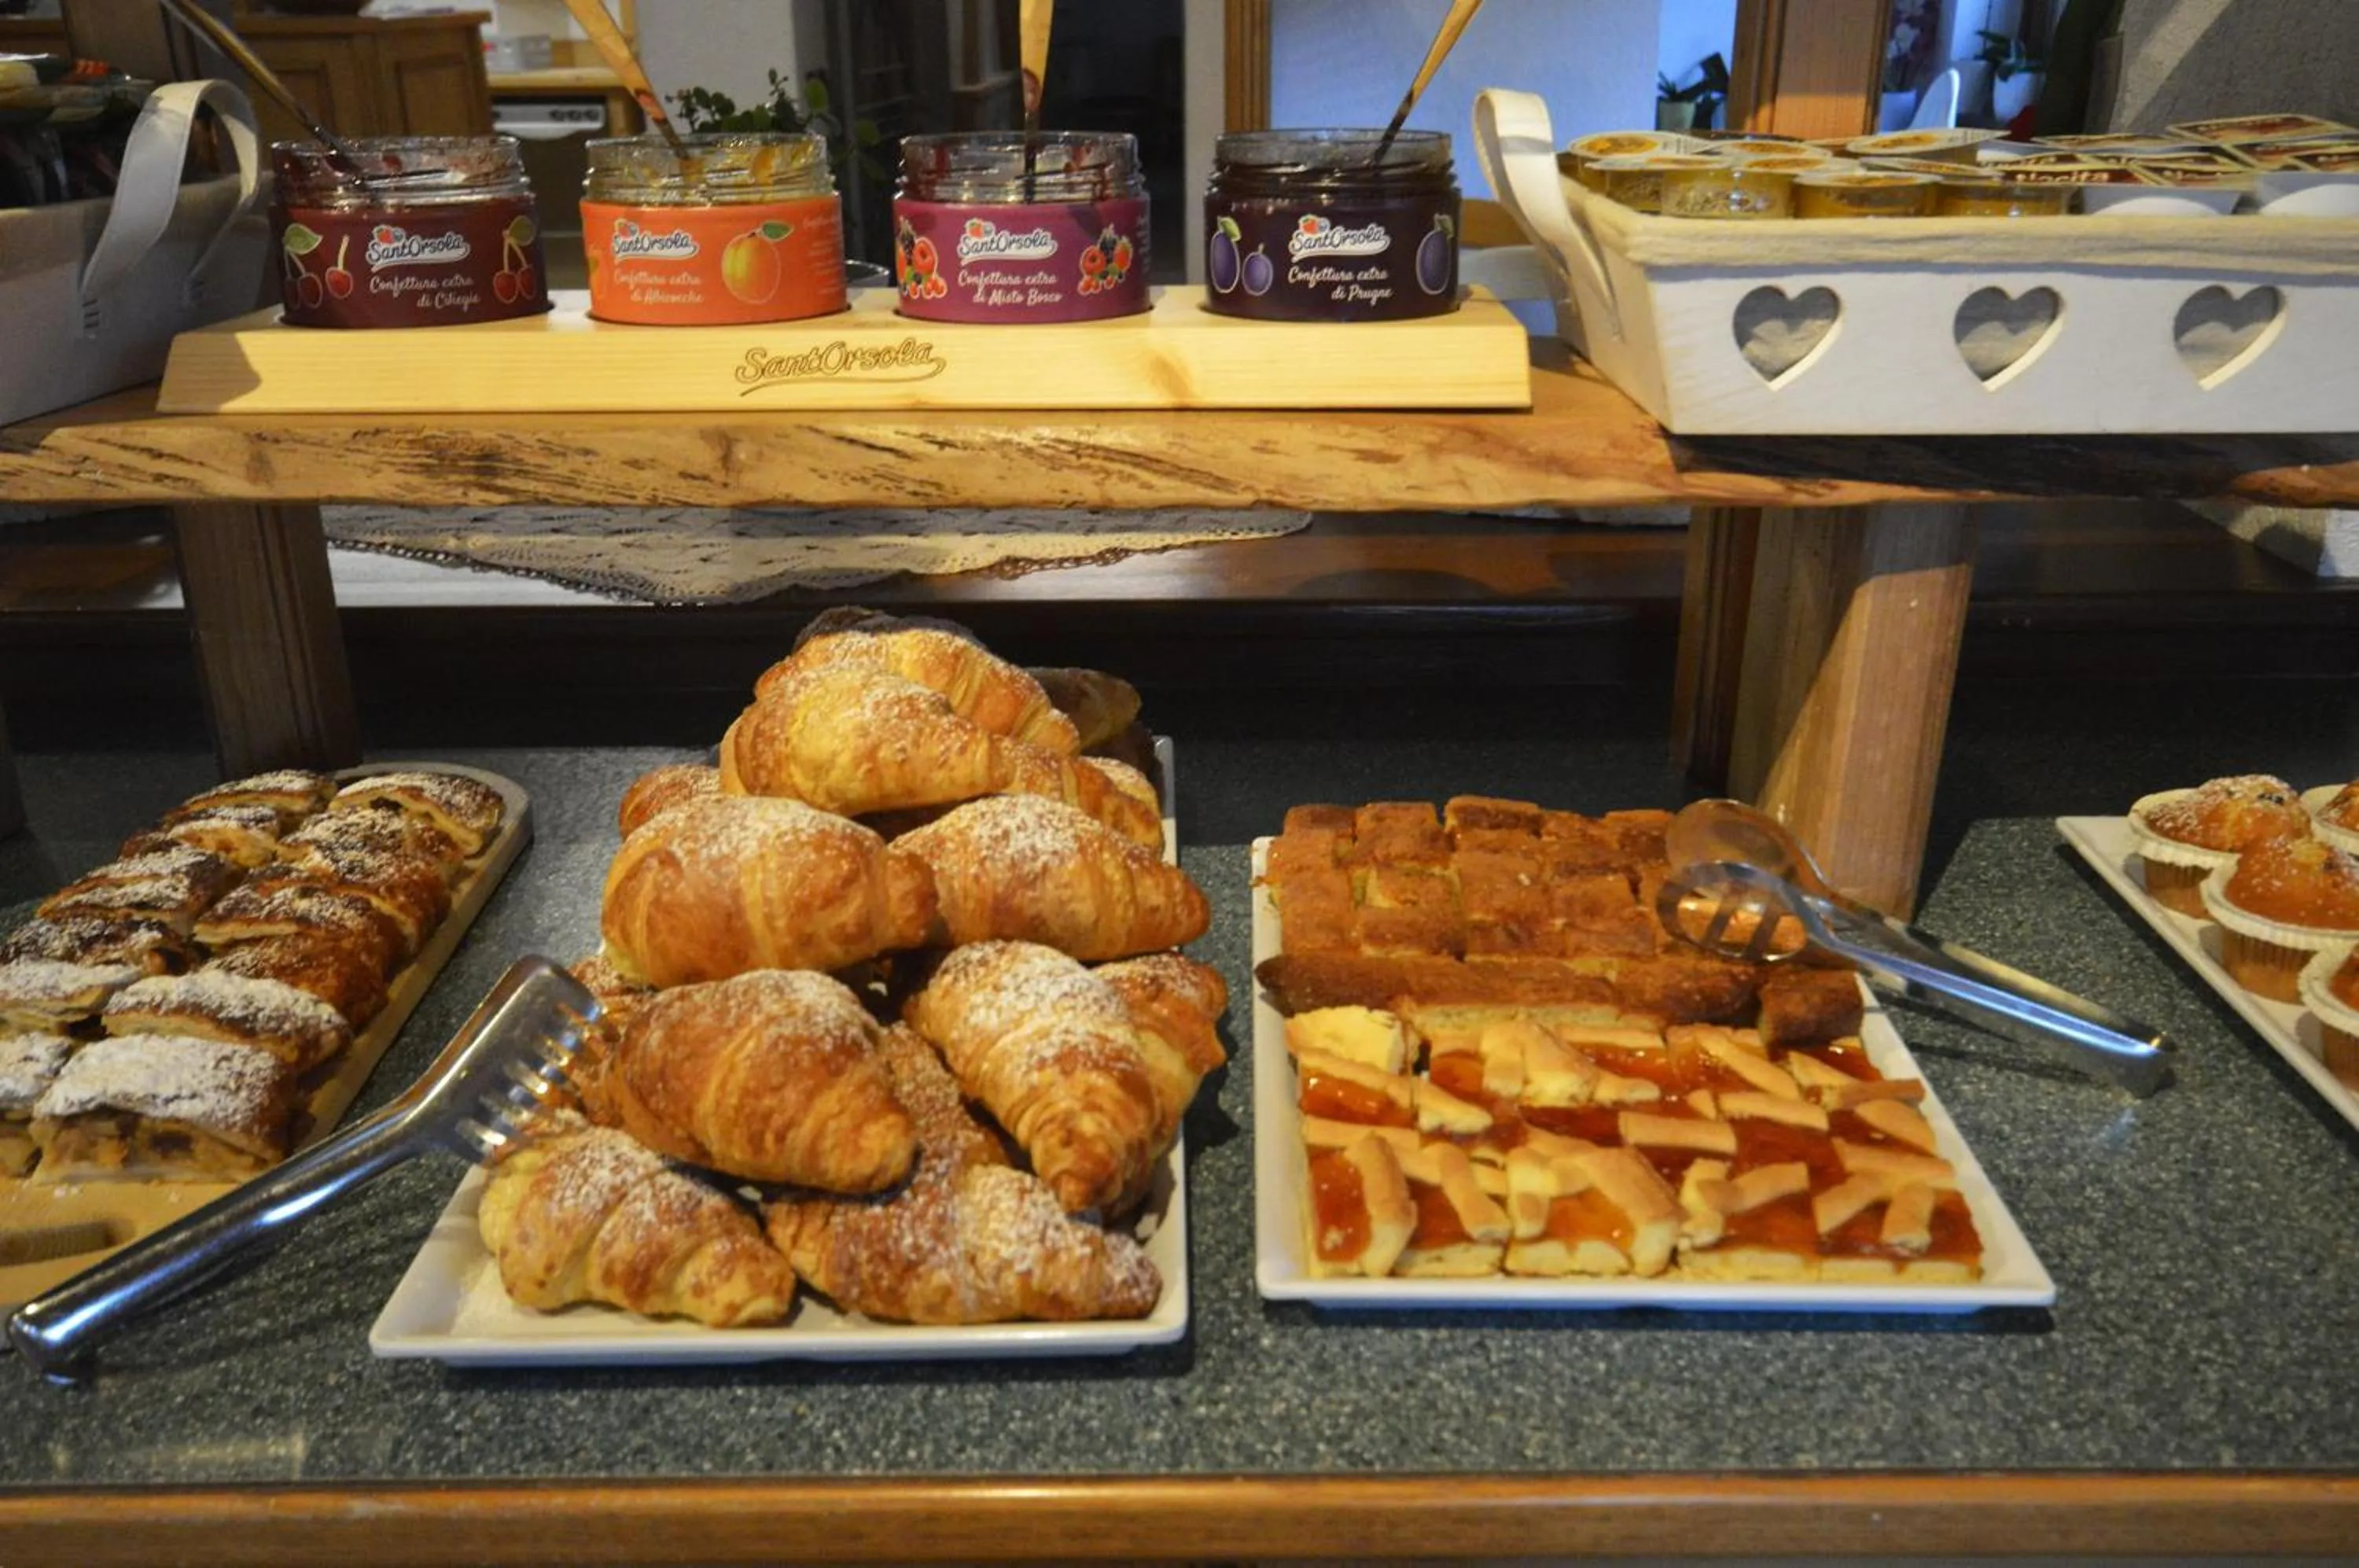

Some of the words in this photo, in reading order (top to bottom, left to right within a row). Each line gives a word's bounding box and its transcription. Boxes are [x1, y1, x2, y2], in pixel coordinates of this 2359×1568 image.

[367, 234, 467, 263] SantOrsola
[613, 231, 698, 256] SantOrsola
[959, 230, 1057, 257] SantOrsola
[1290, 225, 1389, 253] SantOrsola
[370, 275, 439, 298] Confettura
[959, 270, 1022, 296] Confettura
[1288, 266, 1354, 289] Confettura
[734, 337, 947, 384] SantOrsola
